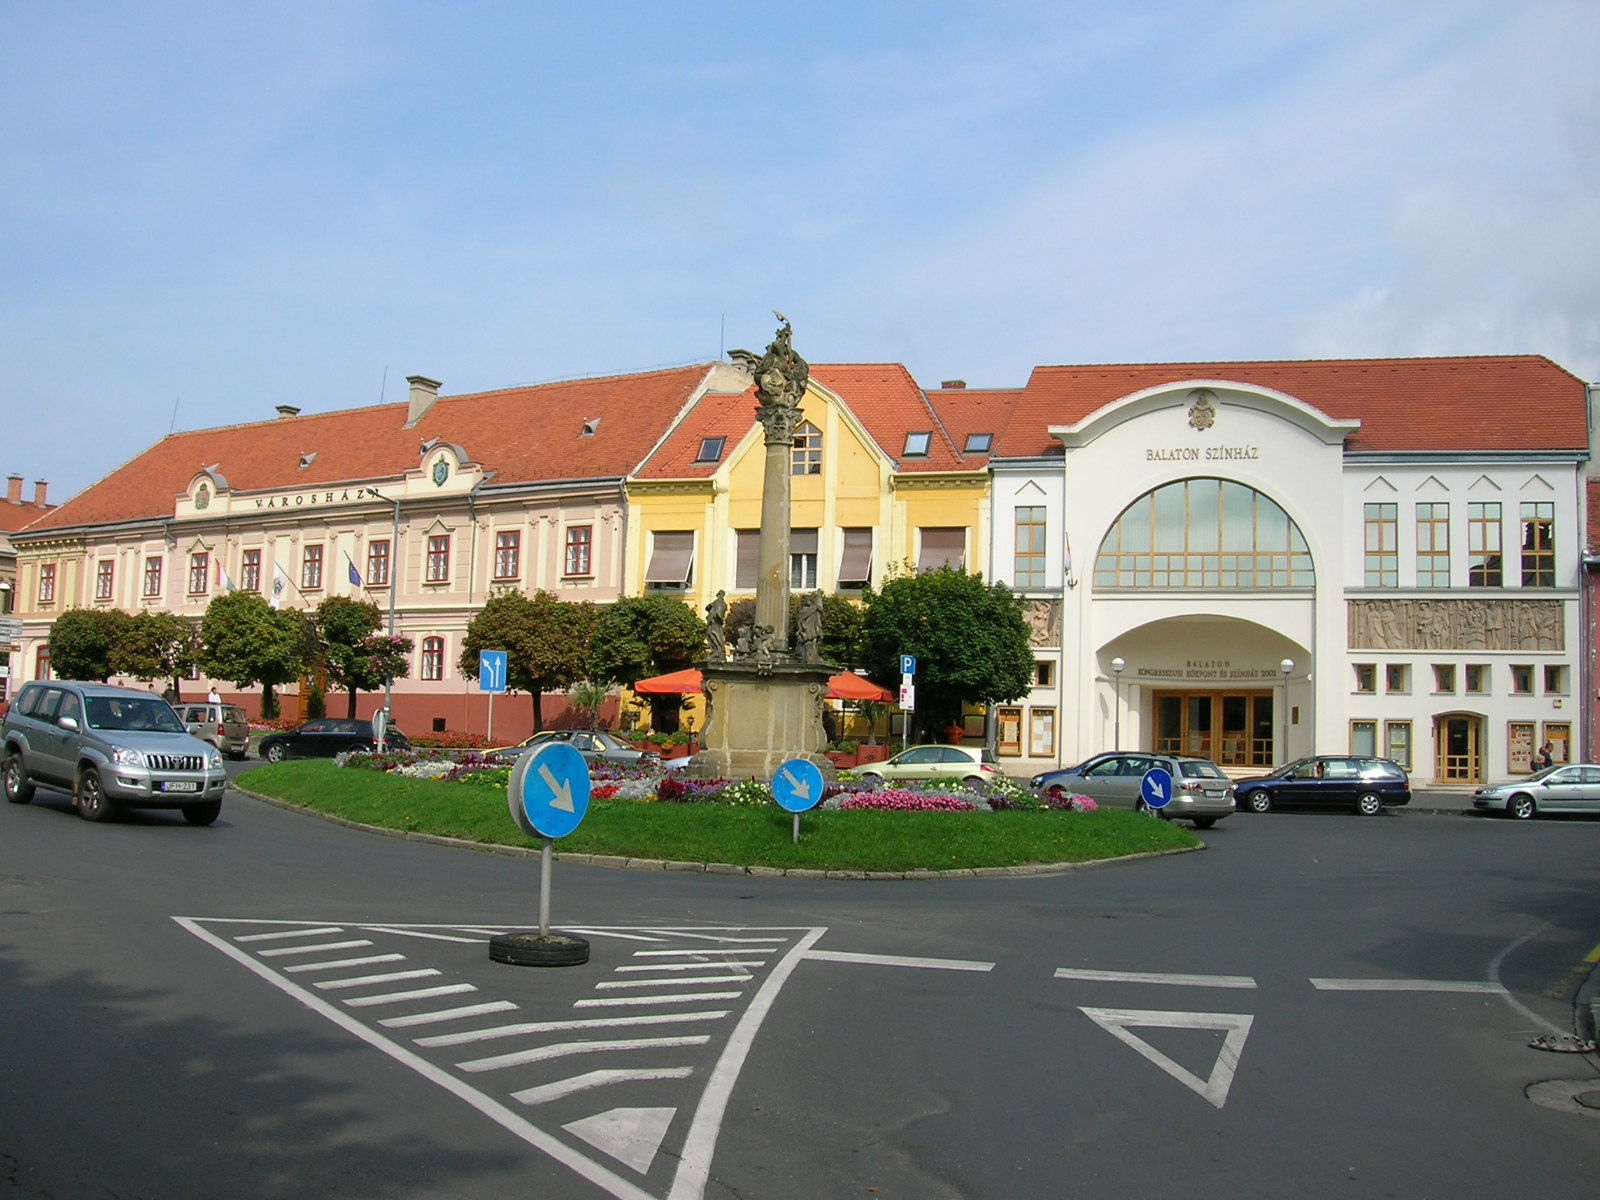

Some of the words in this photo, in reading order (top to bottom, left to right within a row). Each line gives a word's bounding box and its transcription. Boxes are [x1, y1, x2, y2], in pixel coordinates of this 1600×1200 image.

[1146, 448, 1199, 461] BALATON
[1206, 445, 1259, 460] SZÍNHÁZ
[904, 657, 912, 672] P
[1186, 660, 1230, 668] BALATON
